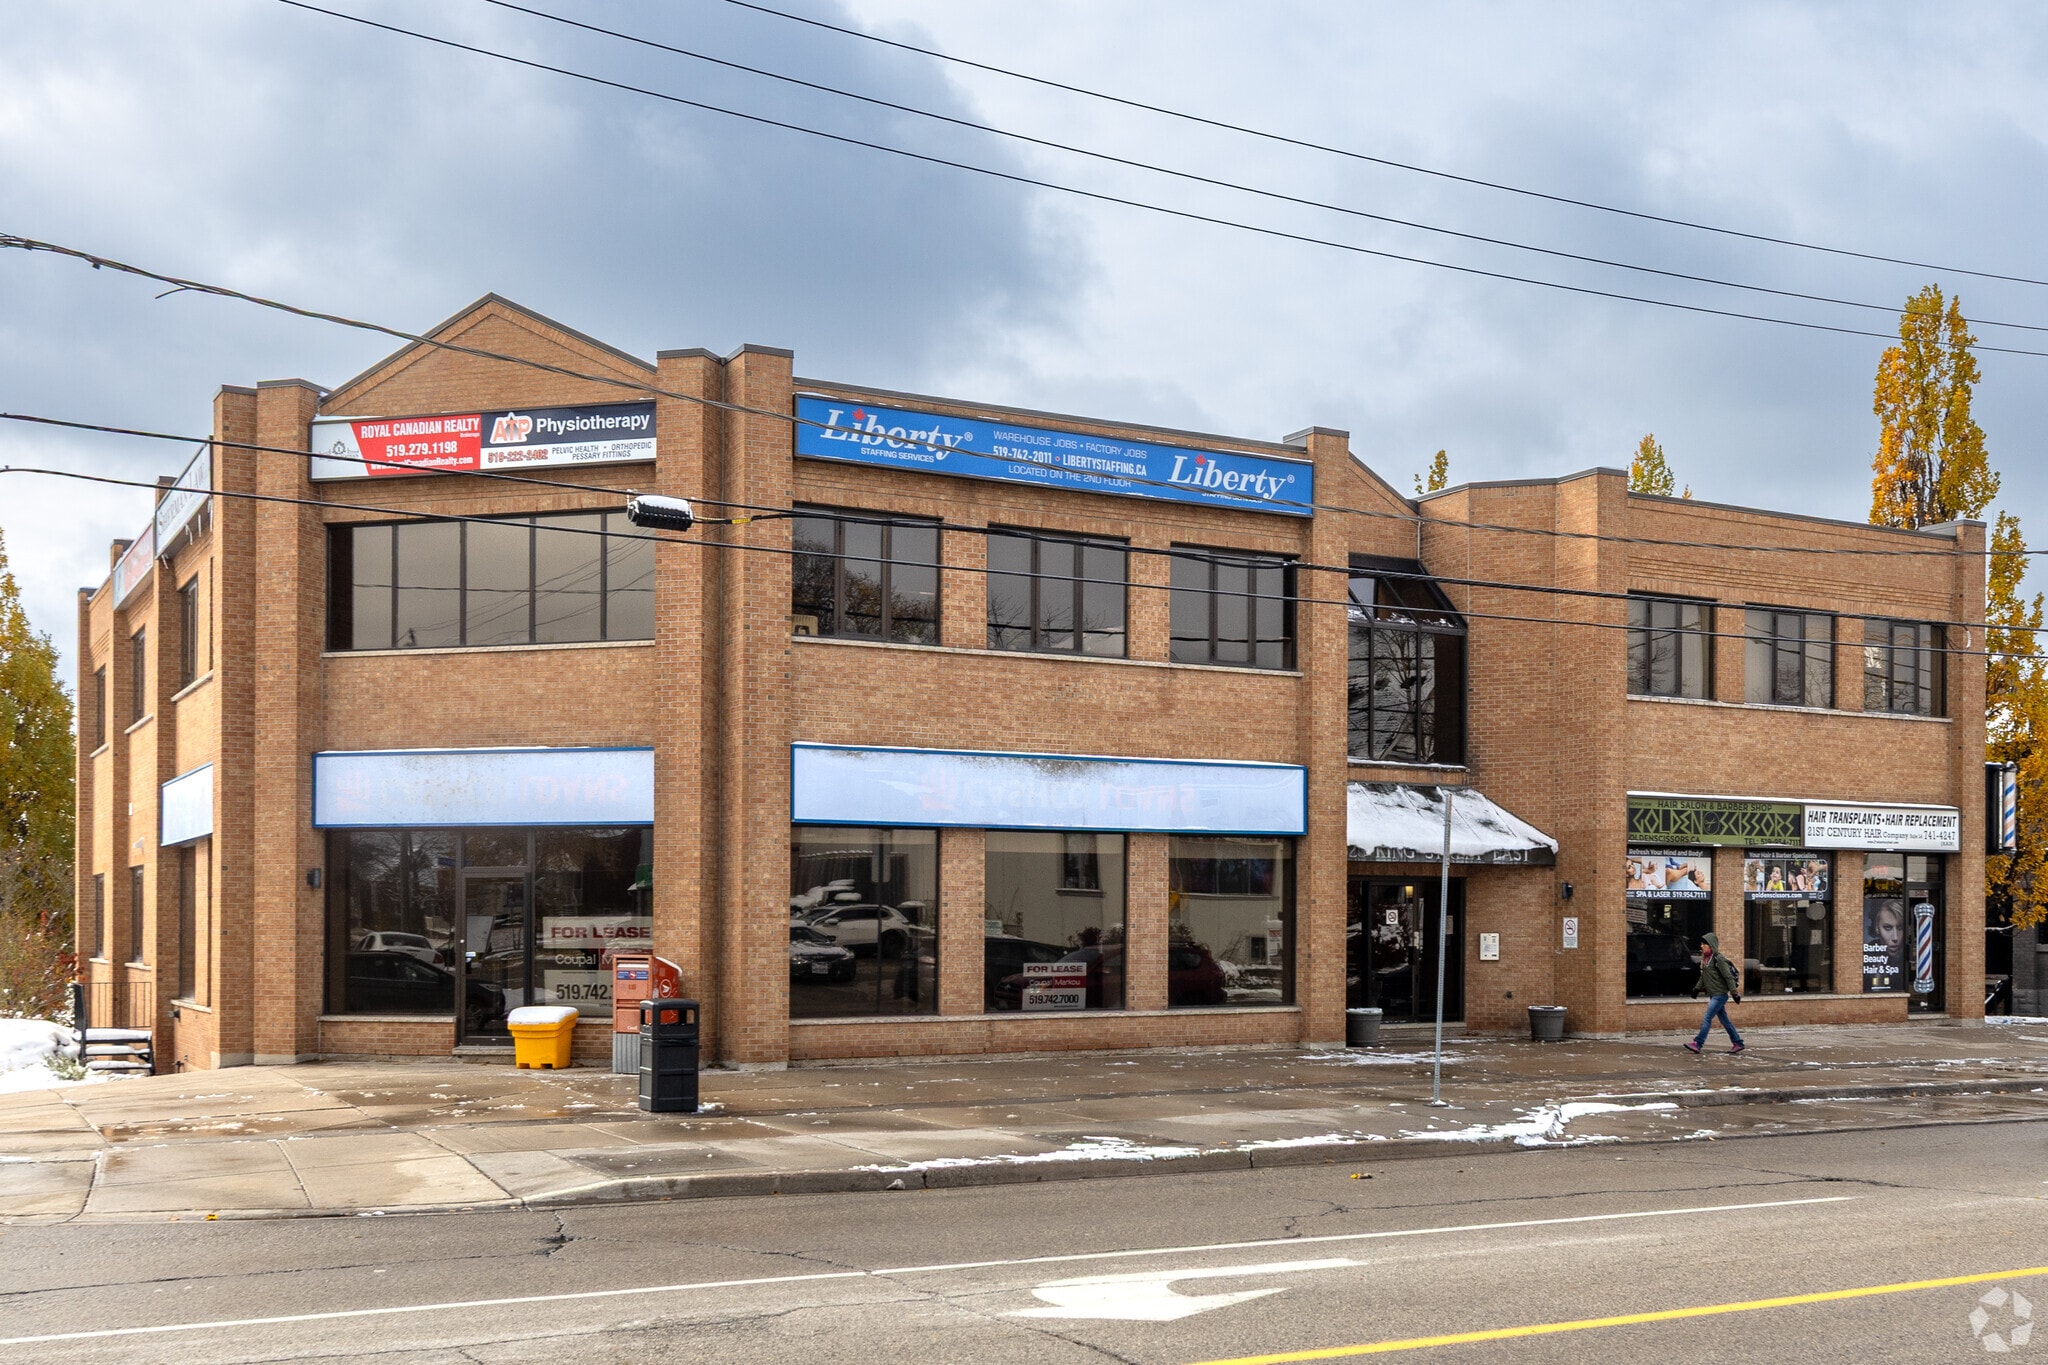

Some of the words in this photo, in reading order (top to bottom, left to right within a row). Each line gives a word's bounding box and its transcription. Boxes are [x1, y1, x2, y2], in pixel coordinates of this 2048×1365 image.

[361, 424, 390, 439] ROYAL
[393, 420, 442, 437] CANADIAN
[444, 417, 480, 433] REALTY
[492, 416, 532, 443] ATP
[536, 414, 650, 436] Physiotherapy
[386, 440, 458, 458] 519.279.1198
[552, 446, 573, 455] PELVIC
[575, 445, 599, 454] HEALTH
[611, 441, 652, 451] ORTHOPEDIC
[993, 430, 1051, 447] WAREHOUSE
[1053, 439, 1078, 450] JOBS
[1086, 442, 1122, 455] FACTORY
[1124, 448, 1147, 459] JOBS
[572, 451, 601, 461] PESSARY
[602, 450, 631, 459] FITTINGS
[861, 447, 897, 459] STAFFING
[898, 451, 935, 463] SERVICES
[993, 445, 1052, 464] 519-742-2011
[1063, 453, 1147, 476] LIBERTYSTAFFING.CA
[1008, 464, 1048, 477] LOCATED
[1050, 469, 1063, 479] ON
[1065, 471, 1081, 482] THE
[1657, 800, 1678, 809] HAIR
[1680, 800, 1707, 810] SALON
[1717, 801, 1749, 811] BARBER
[1751, 803, 1773, 811] SHOP
[1632, 808, 1703, 835] GOLDEN
[1720, 811, 1795, 837] SCISSORS
[1808, 810, 1827, 823] HAIR
[1829, 811, 1881, 825] TRANSPLANTS
[1885, 814, 1904, 826] HAIR
[1905, 814, 1957, 828] REPLACEMENT
[1629, 834, 1700, 843] OLDENSCISSORS.CA
[1807, 826, 1825, 837] 21ST
[1827, 827, 1862, 838] CENTURY
[1864, 828, 1882, 838] HAIR
[1883, 831, 1909, 840] Company
[1924, 830, 1956, 841] 741-4247
[1376, 847, 1416, 859] KING
[1493, 849, 1529, 862] EAST
[1752, 892, 1803, 900] goldenscissors.com
[551, 926, 588, 938] FOR
[593, 926, 650, 938] LEASE
[1863, 943, 1888, 952] Barber
[555, 954, 596, 967] Coupal
[1863, 954, 1889, 965] Beauty
[1026, 965, 1048, 973] FOR
[1051, 965, 1083, 973] LEASE
[1863, 965, 1878, 974] Hair
[1878, 965, 1884, 974] &
[1885, 965, 1899, 976] Spa
